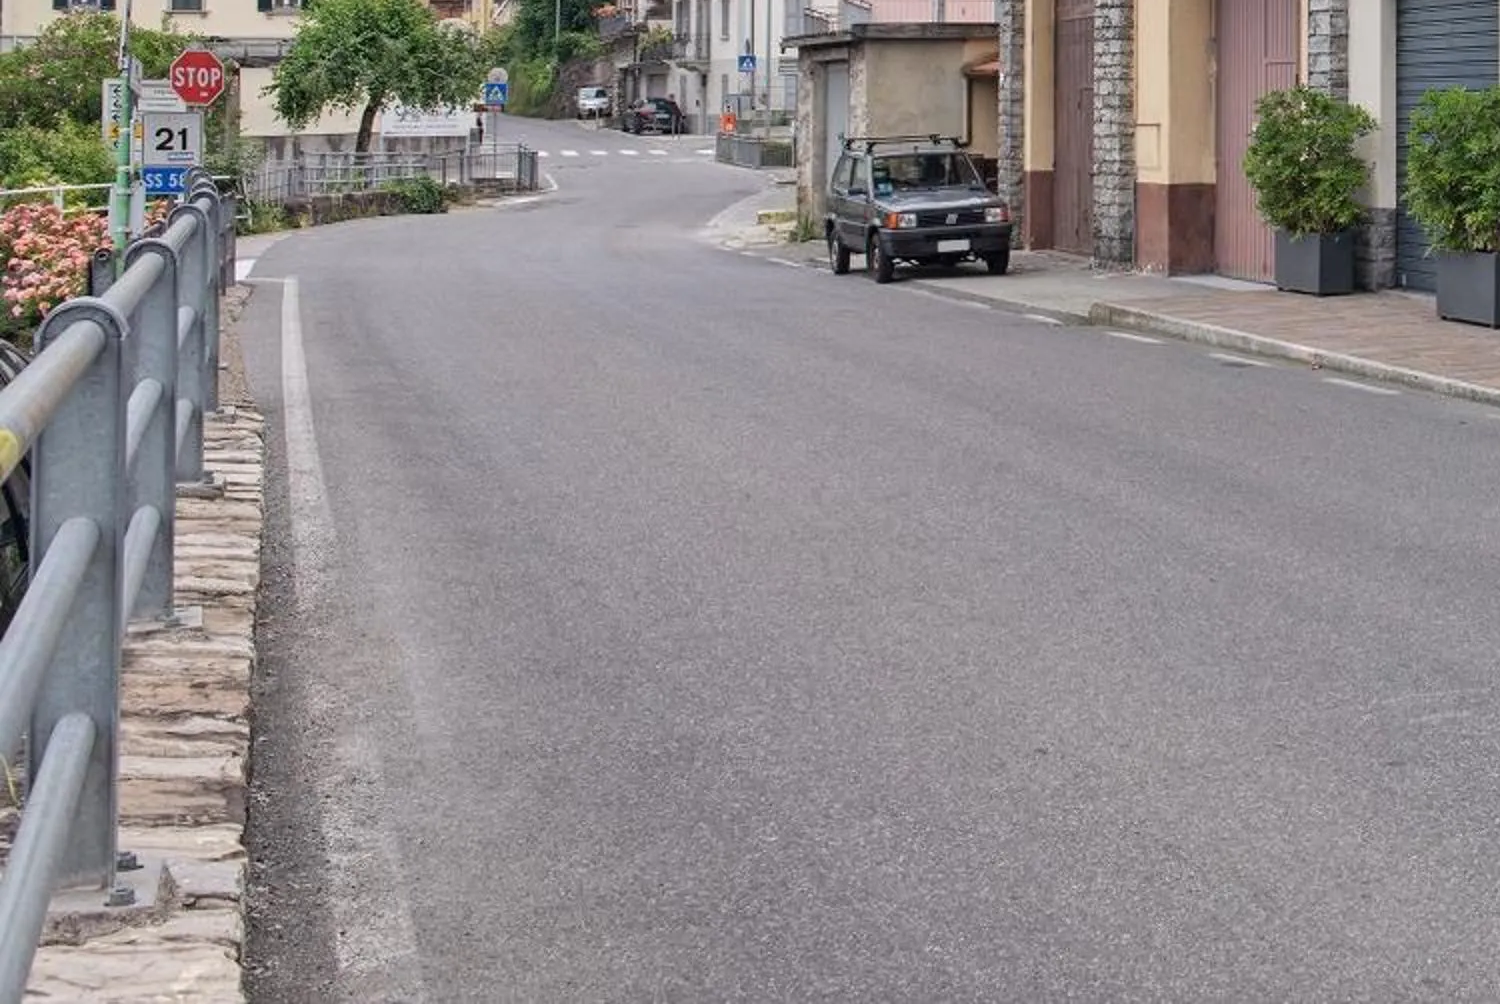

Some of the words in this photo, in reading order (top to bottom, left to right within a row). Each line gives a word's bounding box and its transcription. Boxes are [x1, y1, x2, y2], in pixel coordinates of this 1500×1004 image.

[175, 67, 221, 87] STOP
[155, 127, 187, 150] 21
[145, 173, 163, 188] SS
